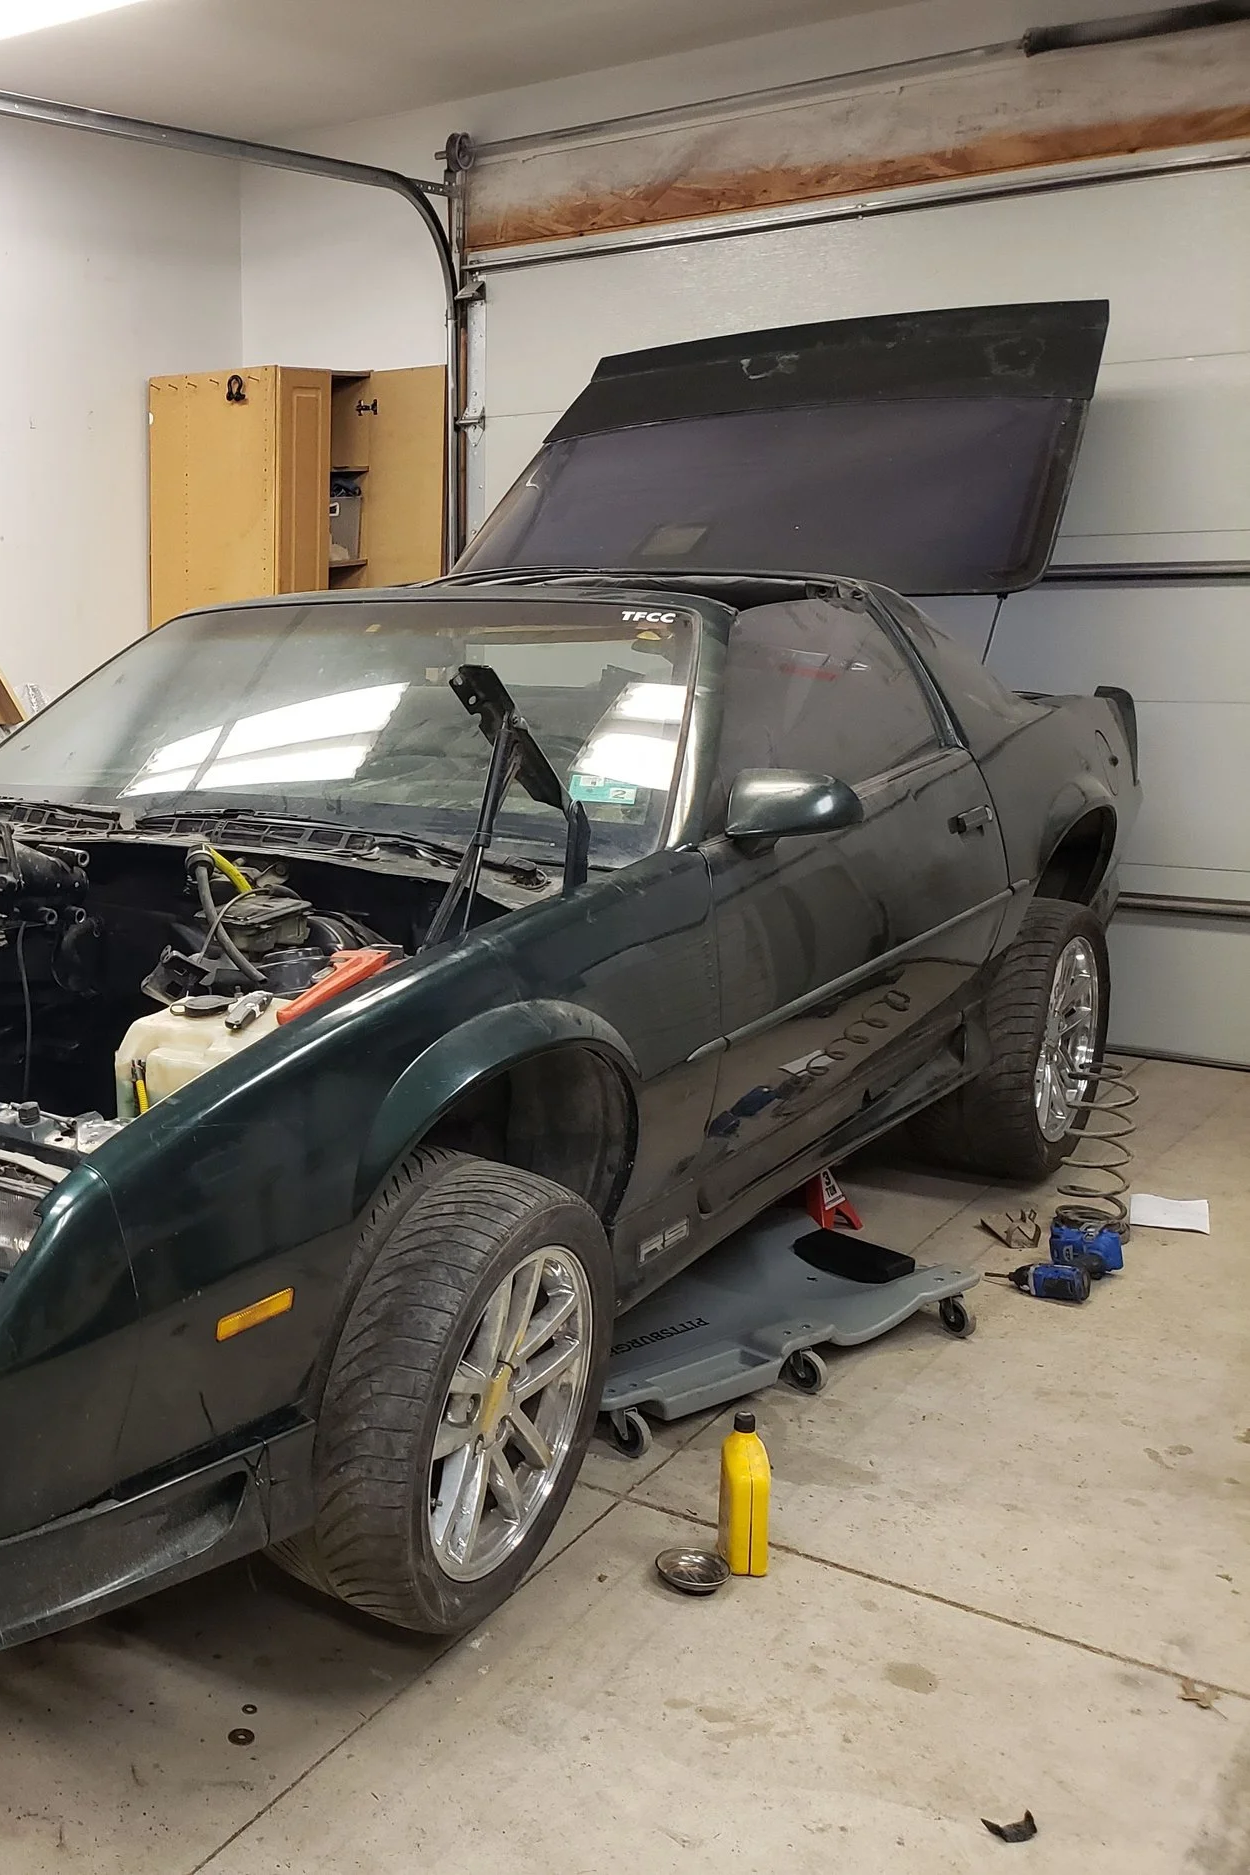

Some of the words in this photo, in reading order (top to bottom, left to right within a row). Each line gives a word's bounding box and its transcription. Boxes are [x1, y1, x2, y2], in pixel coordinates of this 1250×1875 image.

[621, 610, 676, 624] TFCC
[821, 1170, 832, 1187] 3
[639, 1219, 688, 1263] RS
